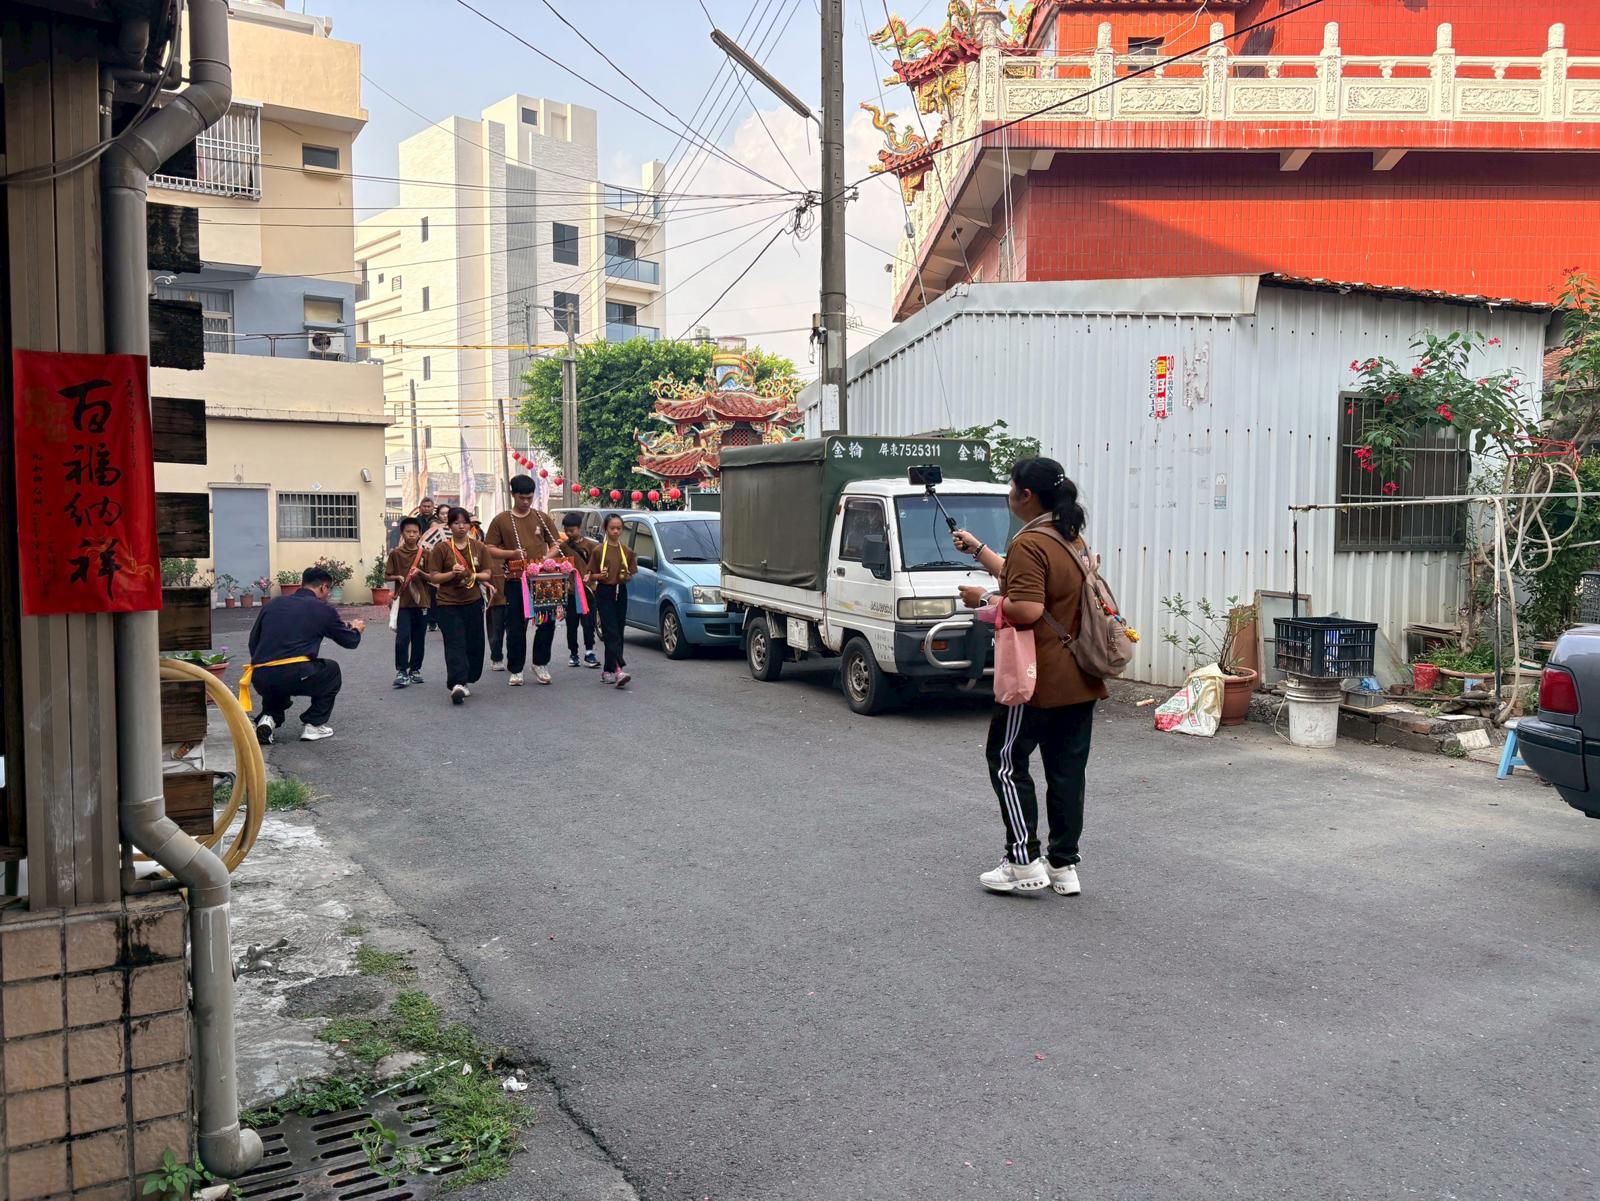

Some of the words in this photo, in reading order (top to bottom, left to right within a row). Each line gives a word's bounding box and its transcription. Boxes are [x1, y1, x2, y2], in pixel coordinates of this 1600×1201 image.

[57, 379, 123, 600] 百福納祥
[831, 440, 864, 459] 金輪
[957, 444, 987, 461] 金輪
